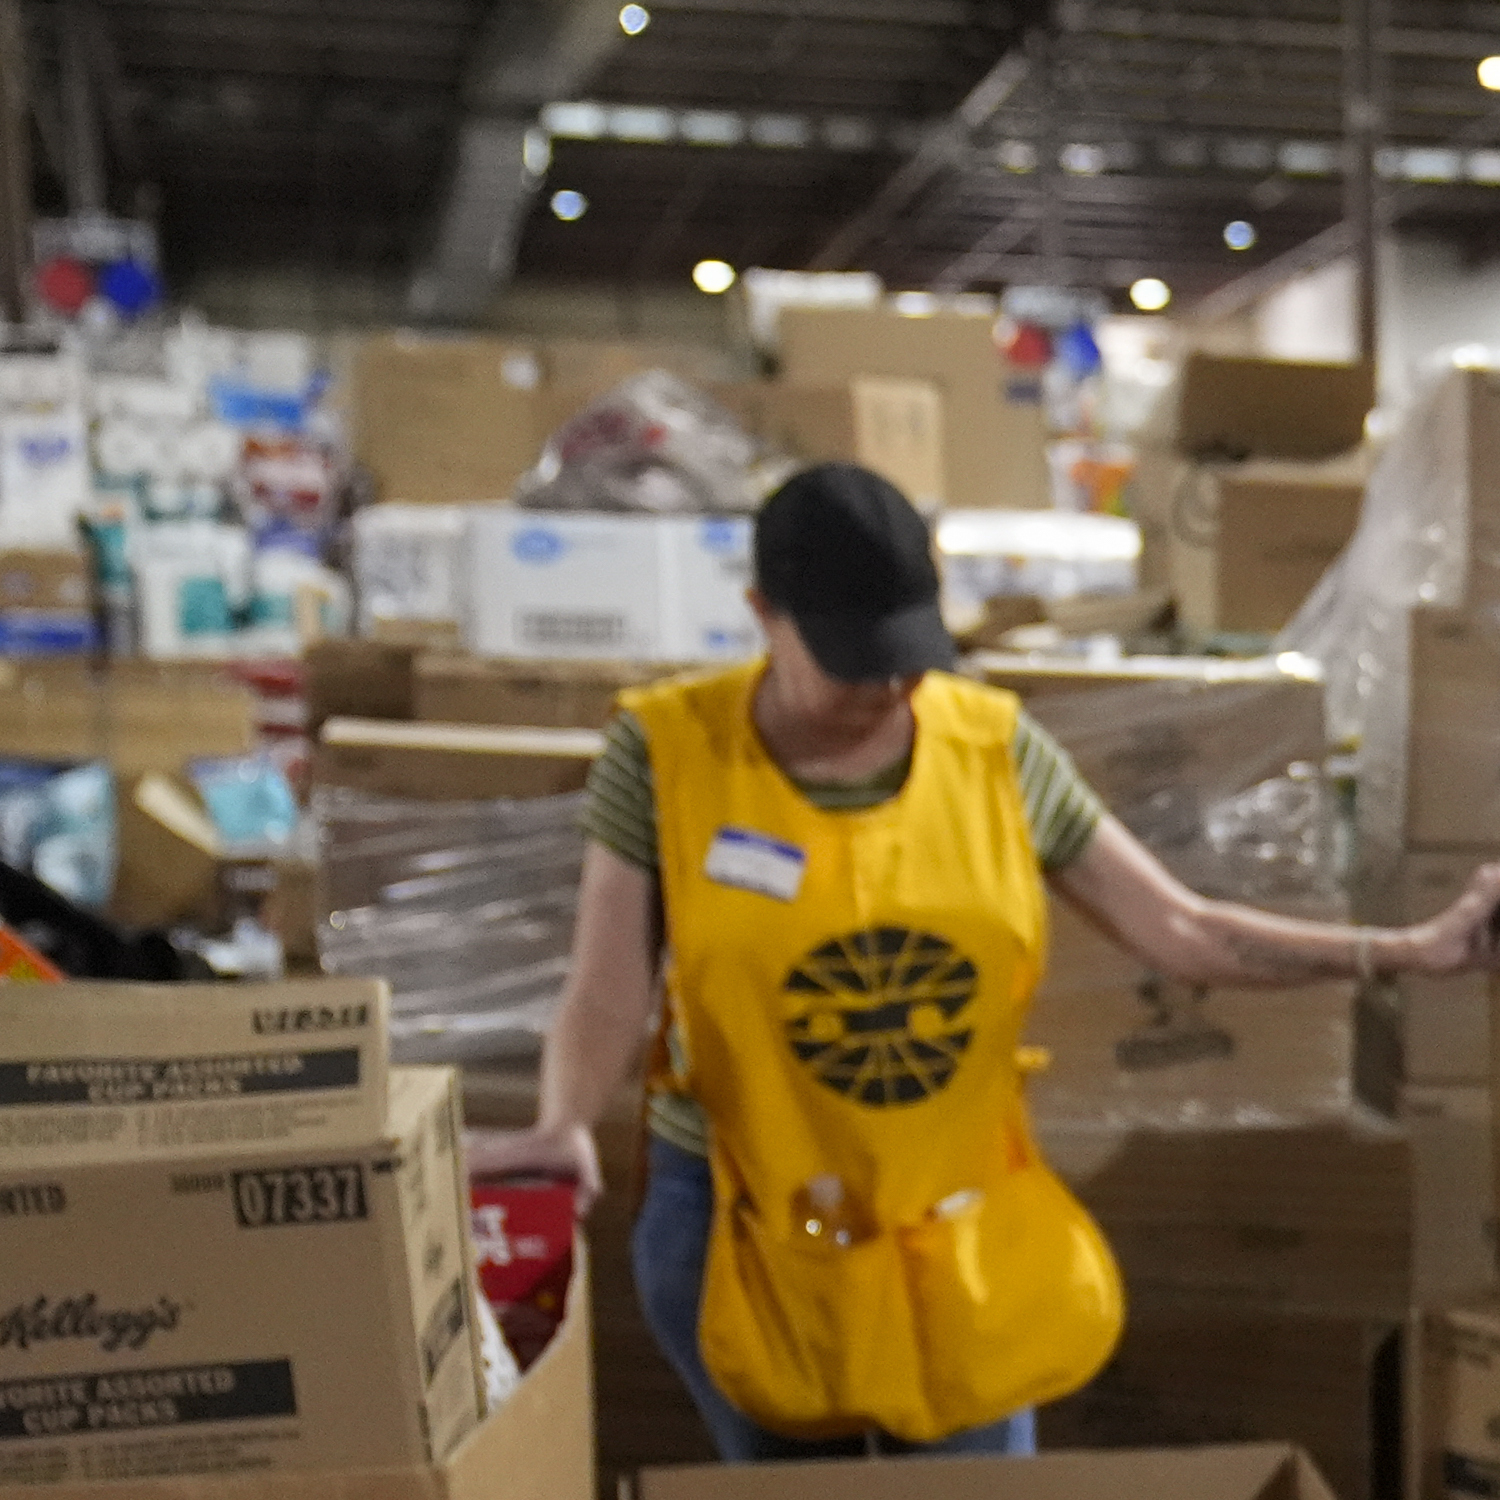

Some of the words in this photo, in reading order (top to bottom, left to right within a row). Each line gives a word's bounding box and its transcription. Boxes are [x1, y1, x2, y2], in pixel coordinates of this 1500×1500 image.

[238, 1166, 363, 1227] 07337
[97, 1366, 235, 1400] ASSORTED
[22, 1405, 80, 1434] CUP
